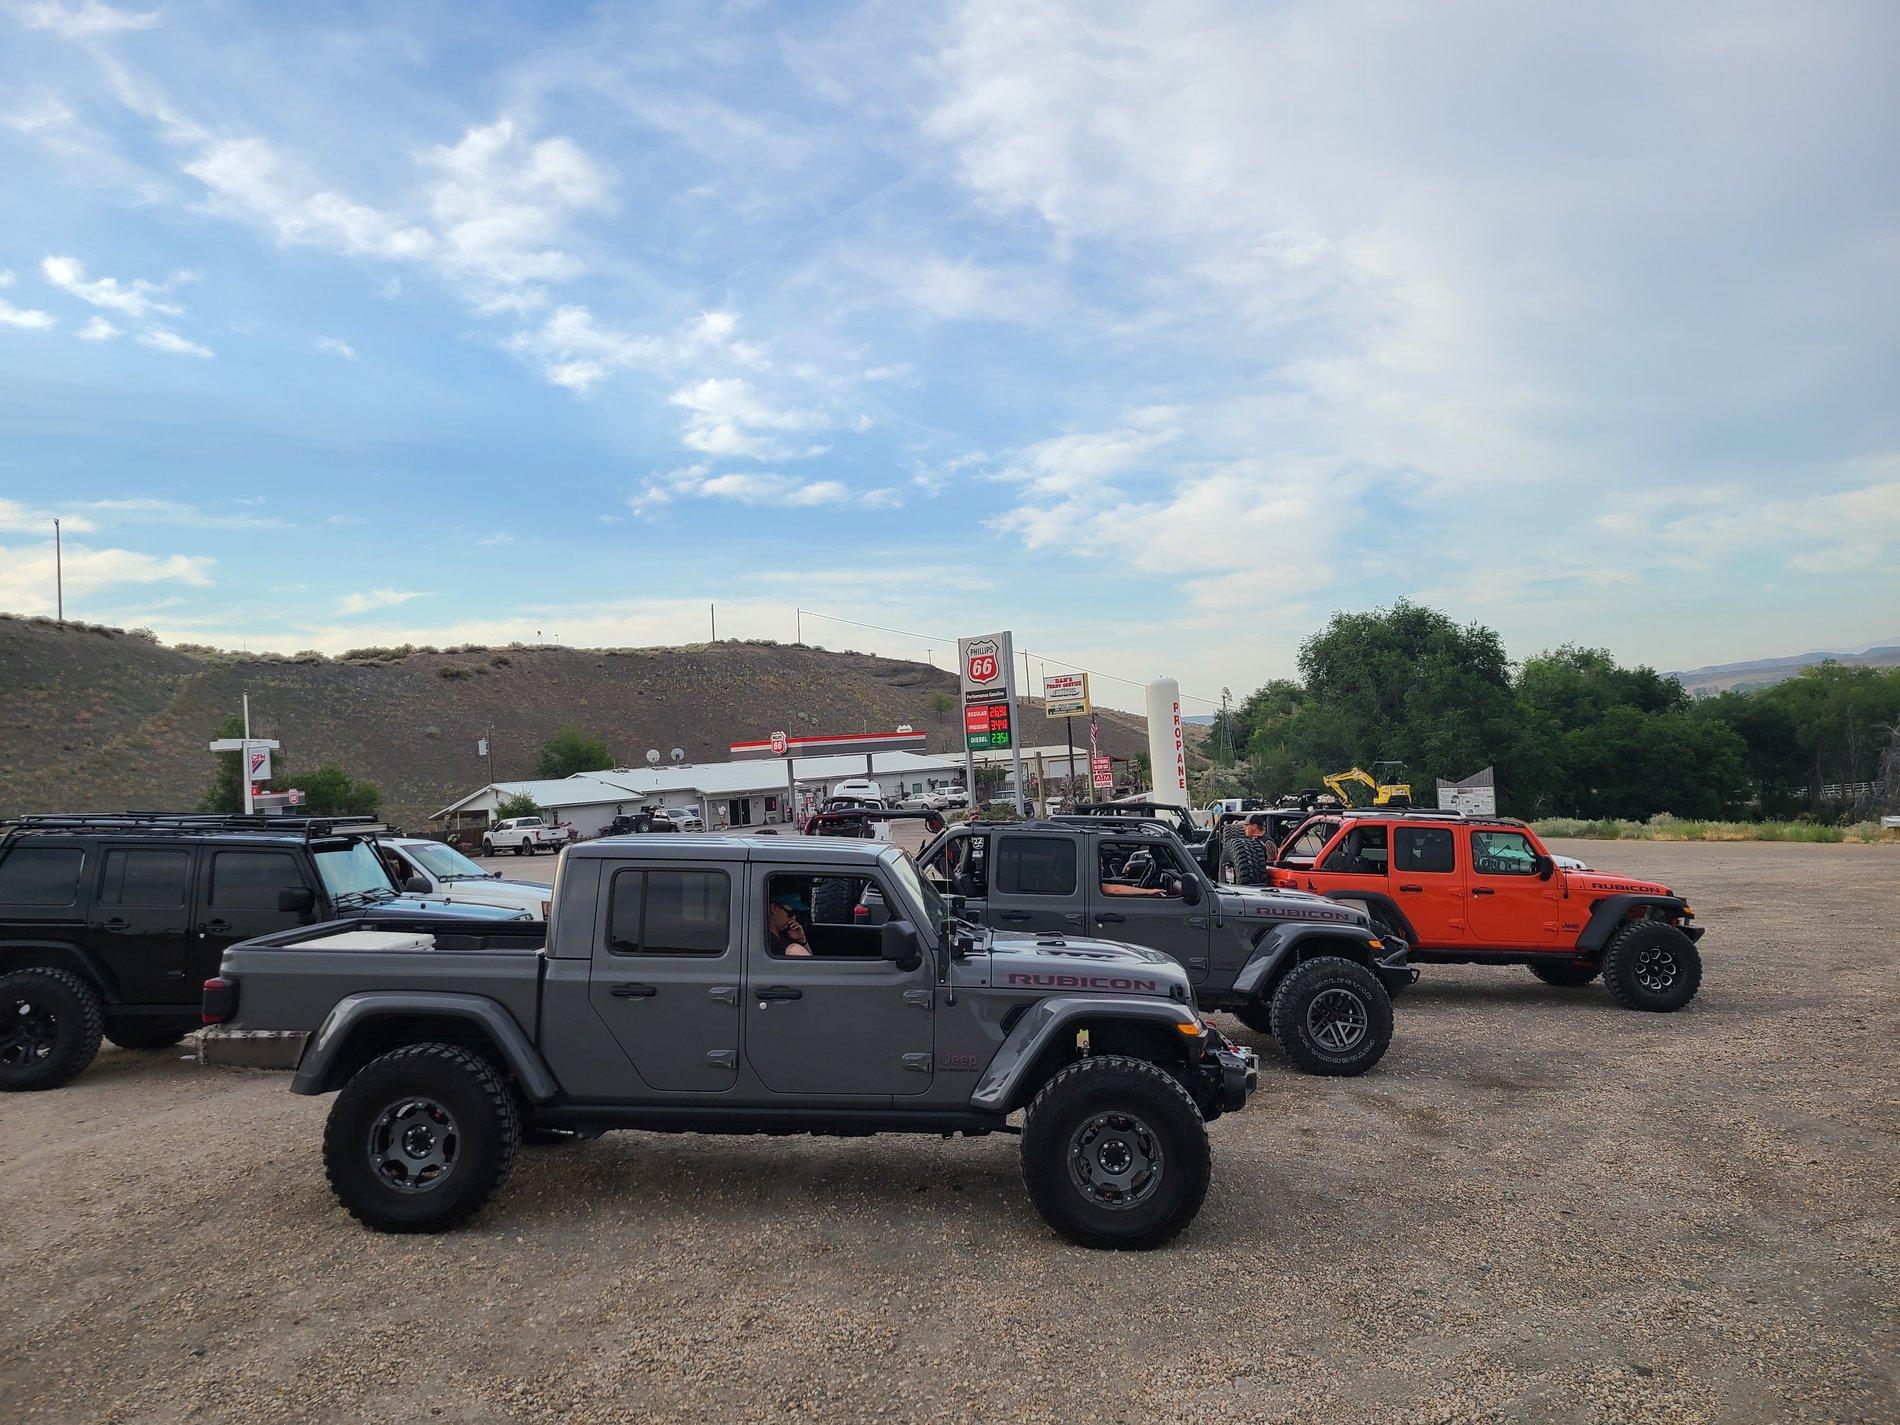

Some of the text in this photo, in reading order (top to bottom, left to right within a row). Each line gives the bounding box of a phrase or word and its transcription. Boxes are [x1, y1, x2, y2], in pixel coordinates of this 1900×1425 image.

[970, 646, 994, 656] PHILLIPS
[973, 658, 992, 676] 66
[774, 741, 782, 750] 66
[1173, 703, 1184, 788] PROPANE
[1592, 883, 1660, 893] RUBICON
[1256, 907, 1349, 920] RUBICON
[1561, 922, 1580, 930] Jeep
[1008, 973, 1156, 991] RUBICON
[941, 1050, 979, 1068] Jeep
